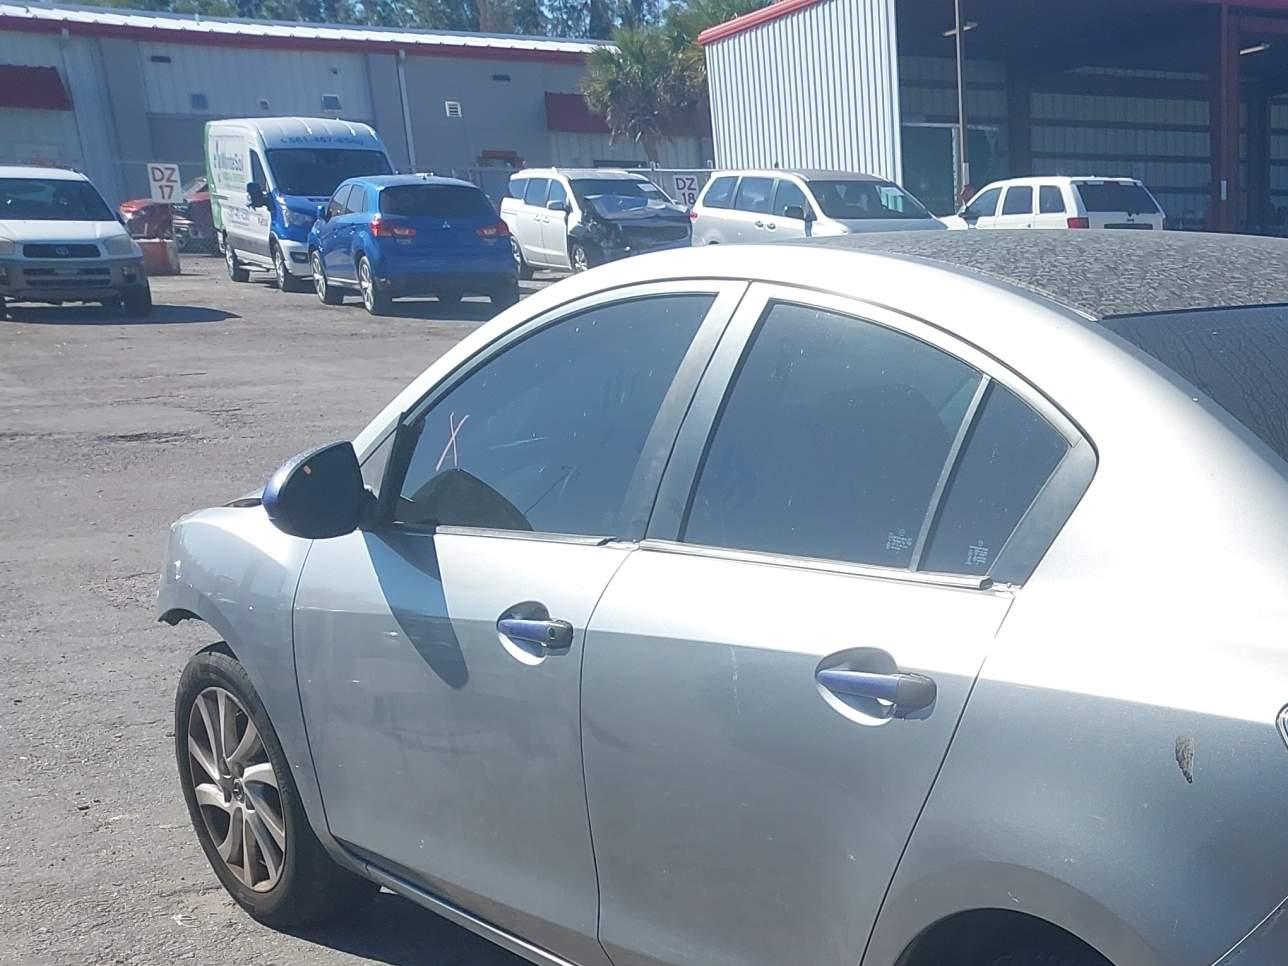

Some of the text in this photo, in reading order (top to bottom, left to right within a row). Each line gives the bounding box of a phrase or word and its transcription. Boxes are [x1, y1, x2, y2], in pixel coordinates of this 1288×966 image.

[151, 166, 178, 183] DZ
[675, 177, 697, 191] DZ
[159, 184, 174, 200] 17
[682, 191, 696, 206] 18
